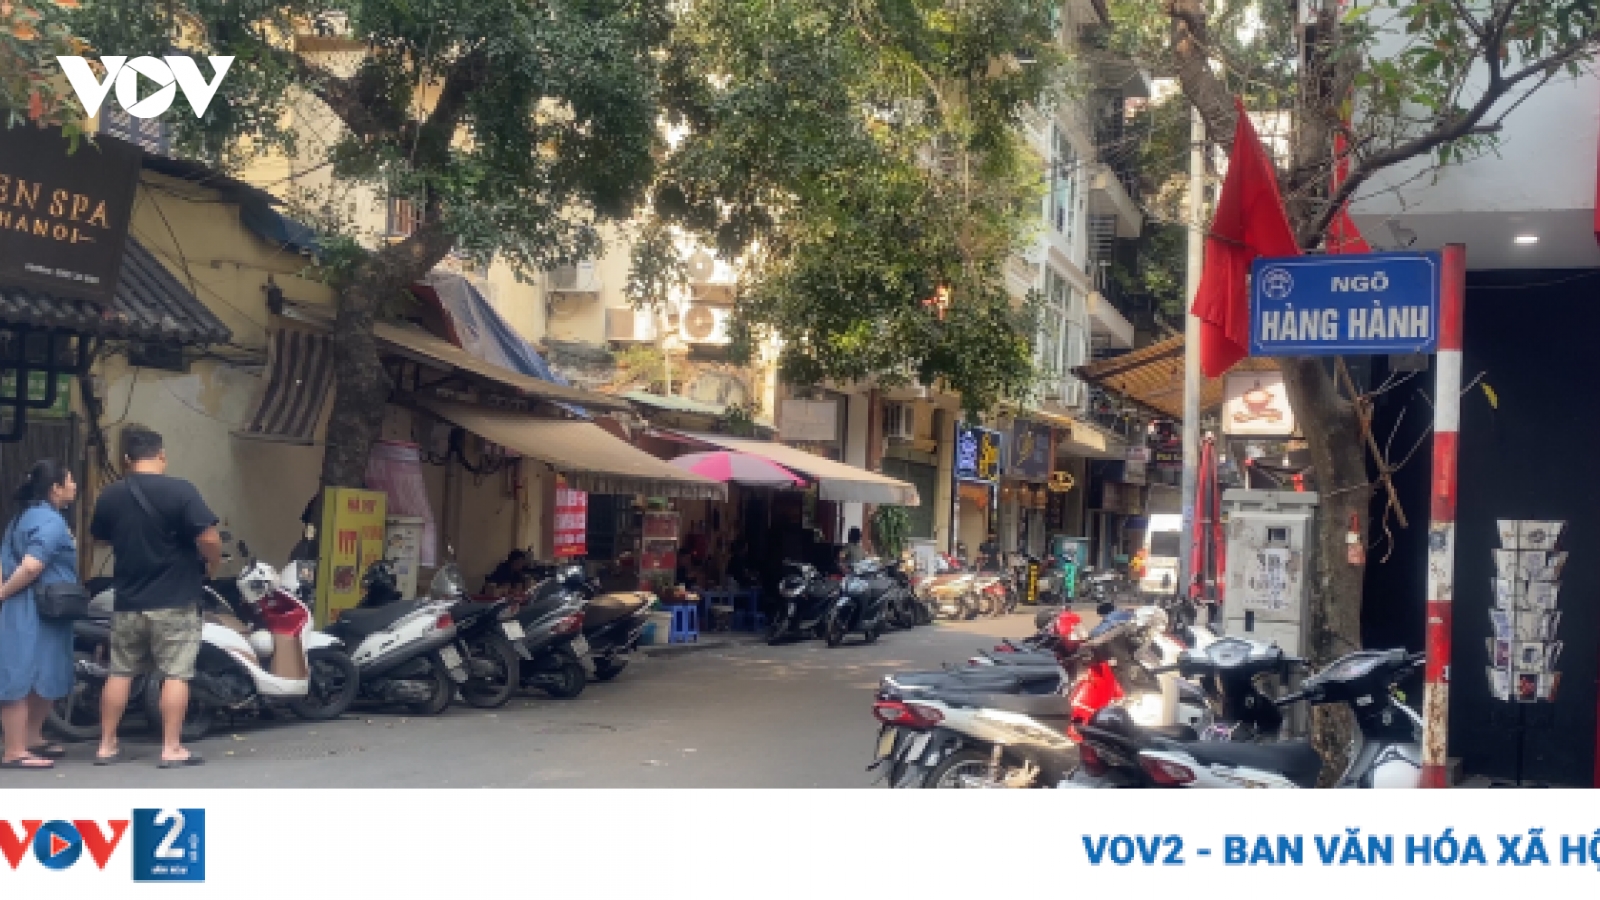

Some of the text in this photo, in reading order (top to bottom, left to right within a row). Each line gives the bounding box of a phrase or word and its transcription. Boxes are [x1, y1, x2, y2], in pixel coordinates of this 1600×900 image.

[0, 211, 80, 244] HANOI
[48, 188, 111, 230] SPA
[1261, 299, 1430, 341] HÀNG HÀNH
